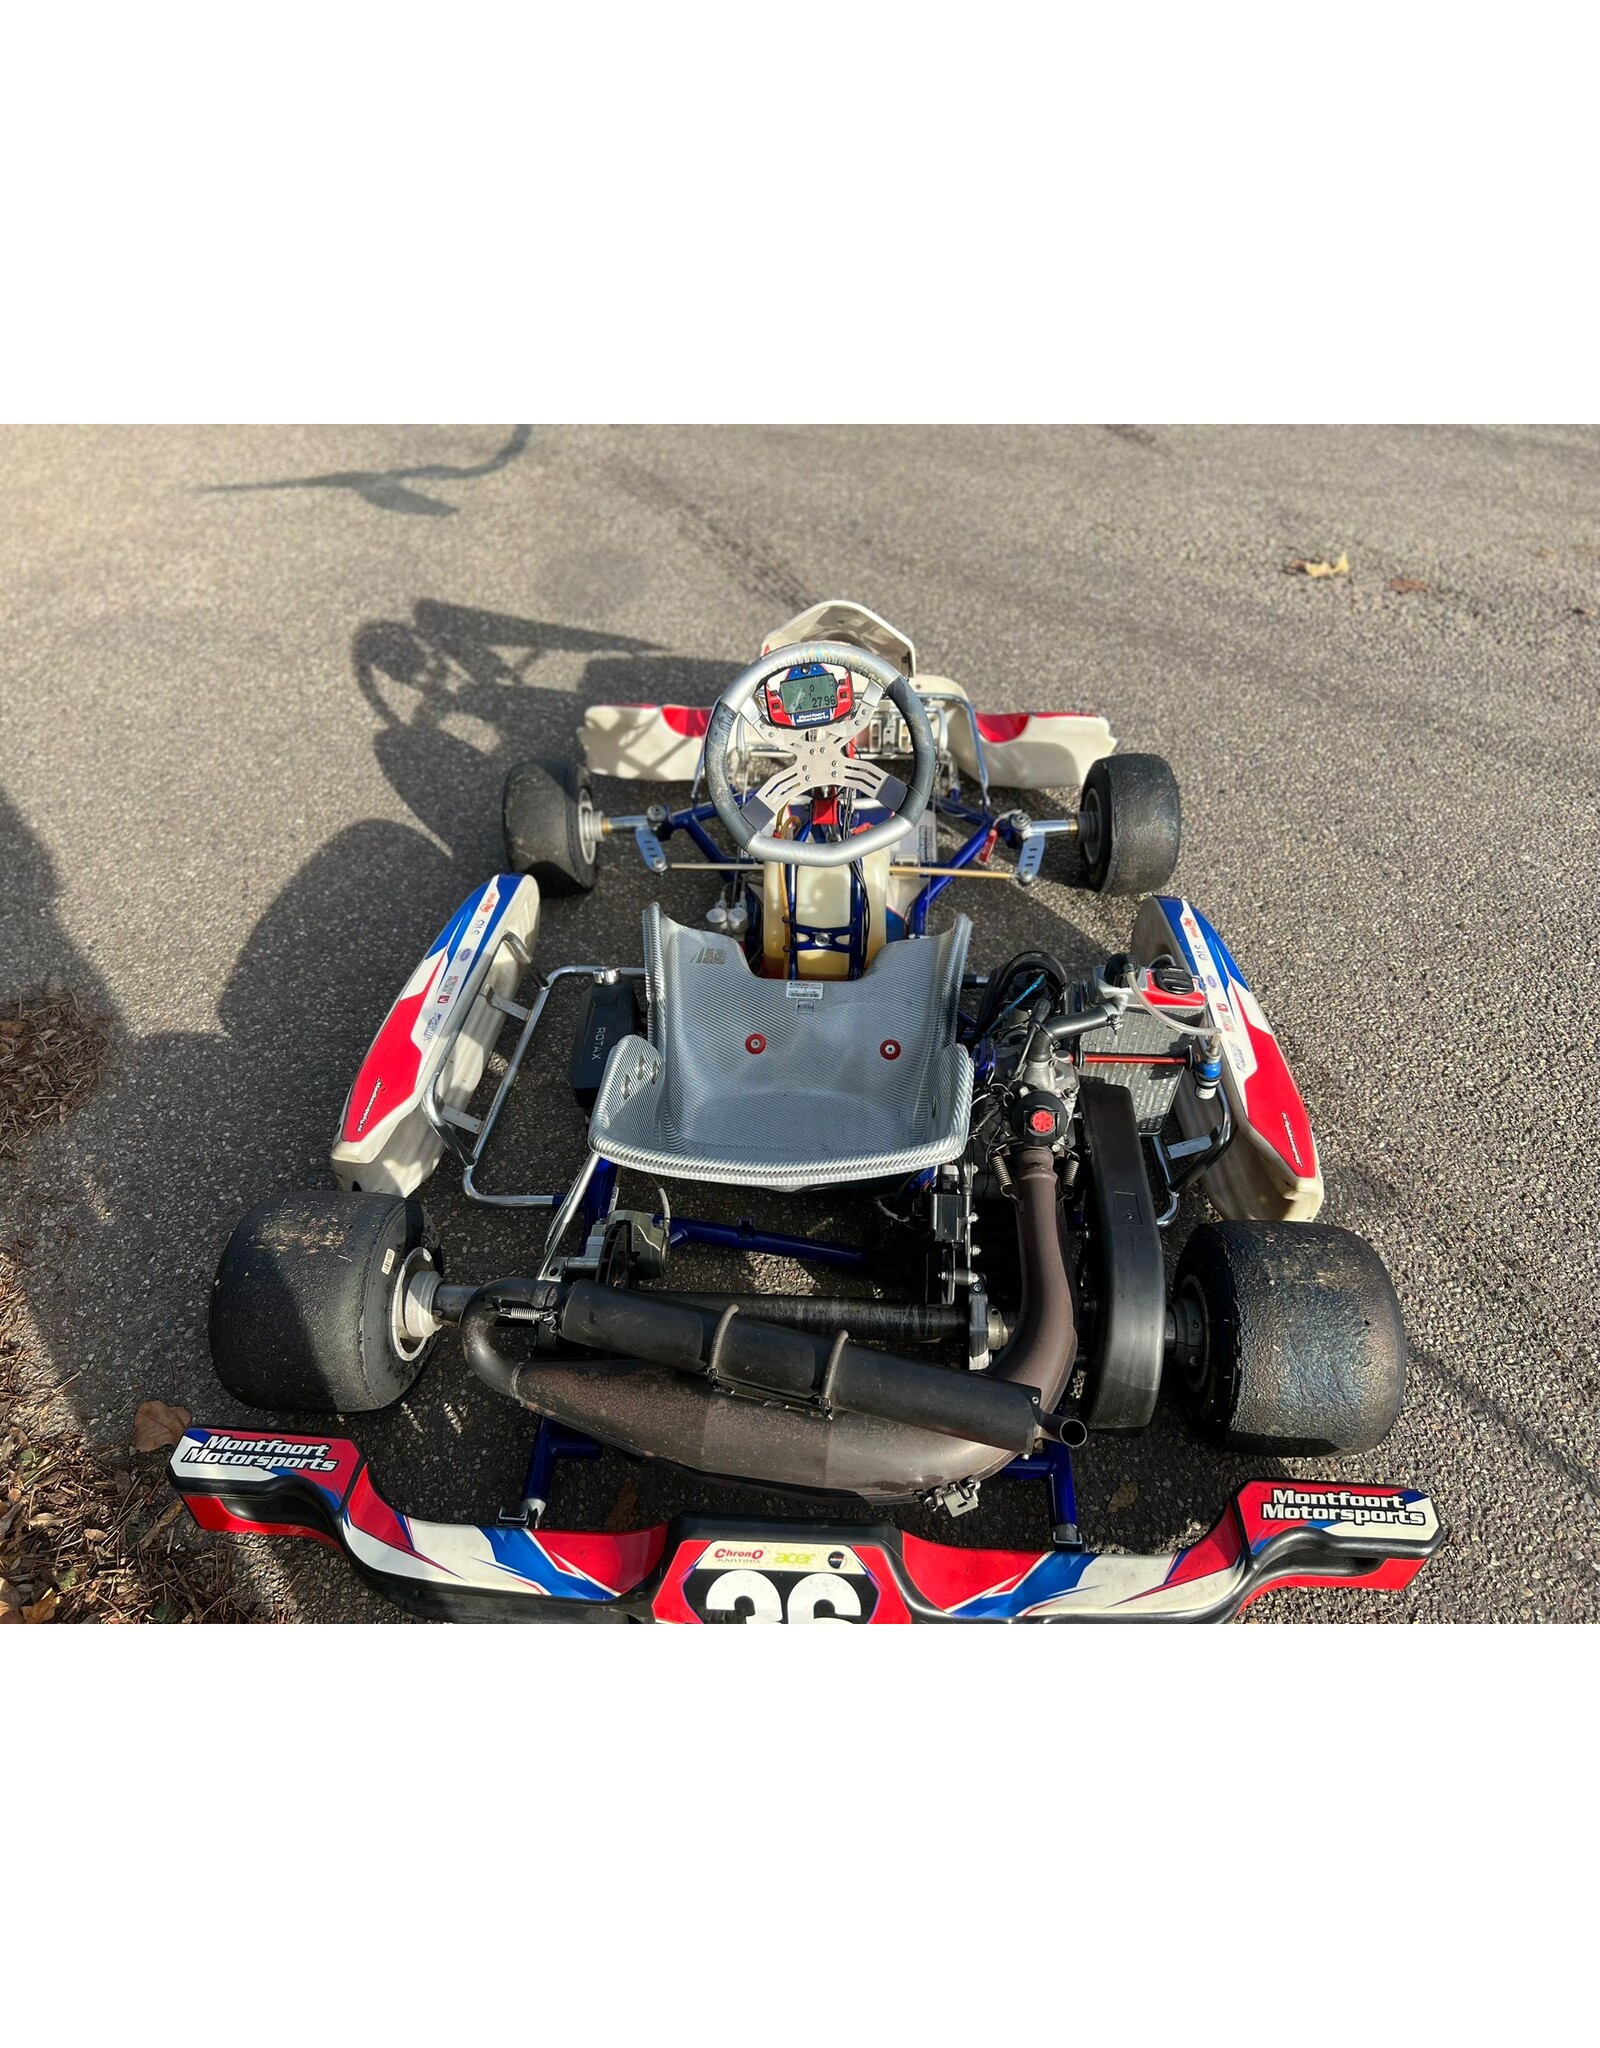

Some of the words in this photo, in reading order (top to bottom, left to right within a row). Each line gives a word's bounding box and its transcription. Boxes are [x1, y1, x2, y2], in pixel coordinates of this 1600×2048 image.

[592, 1027, 606, 1060] ROTAX
[203, 1435, 330, 1457] Montfoort
[183, 1448, 338, 1471] Motorsports
[1273, 1489, 1403, 1508] Montfoort
[1263, 1504, 1425, 1525] Motorsports
[774, 1552, 816, 1564] acer
